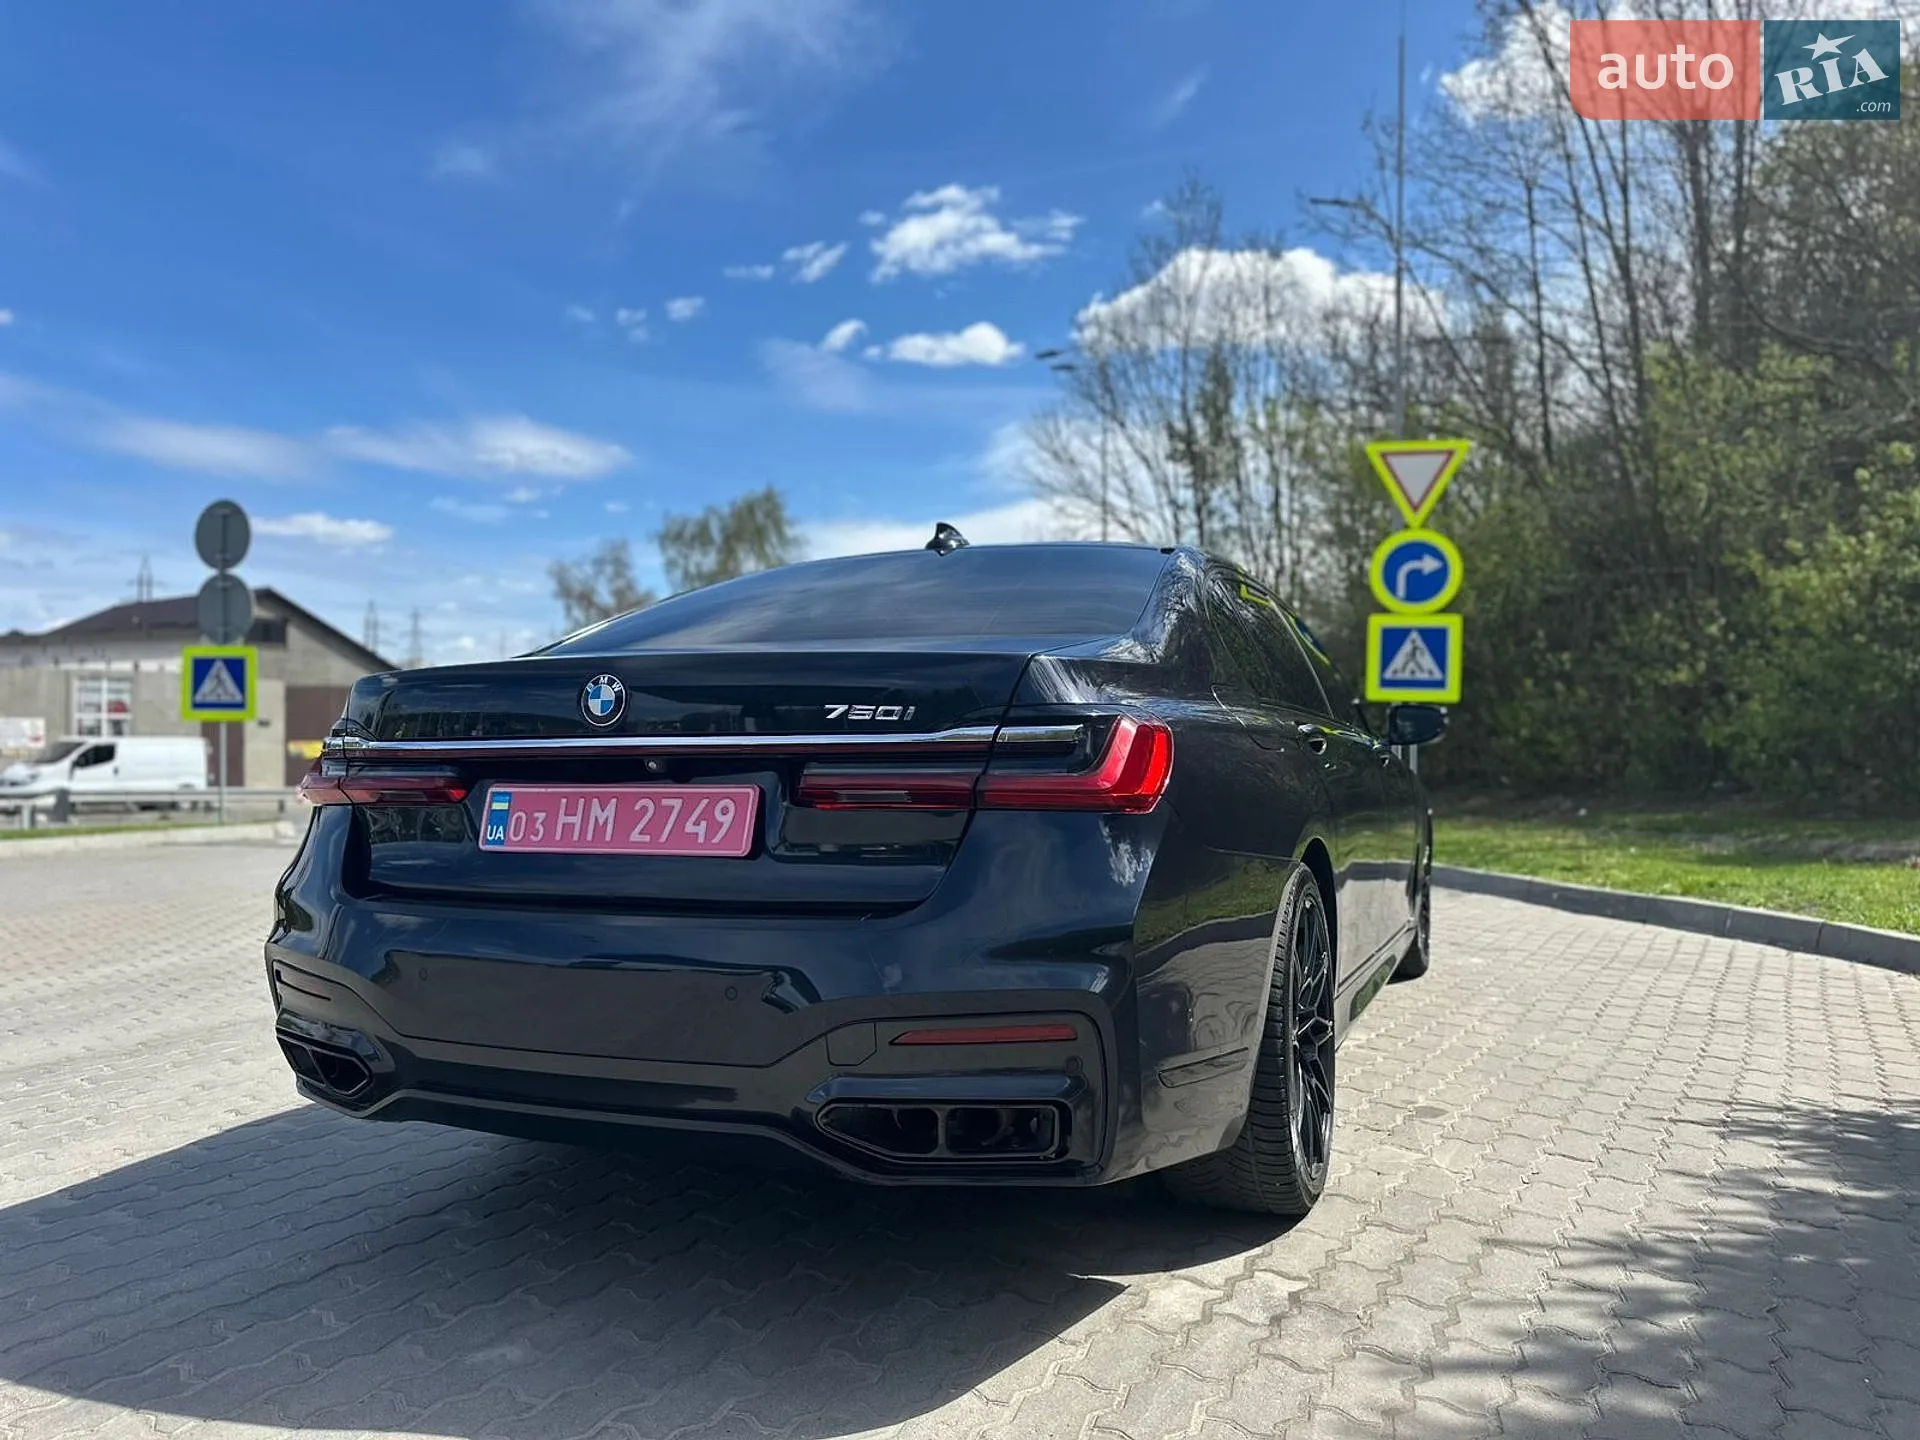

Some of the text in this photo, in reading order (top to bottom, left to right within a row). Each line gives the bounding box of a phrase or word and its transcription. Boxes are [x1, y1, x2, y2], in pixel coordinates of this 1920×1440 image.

[586, 676, 622, 692] BMW
[824, 704, 917, 721] 750i
[509, 798, 737, 844] 03 HM 2749
[486, 825, 505, 841] UA
